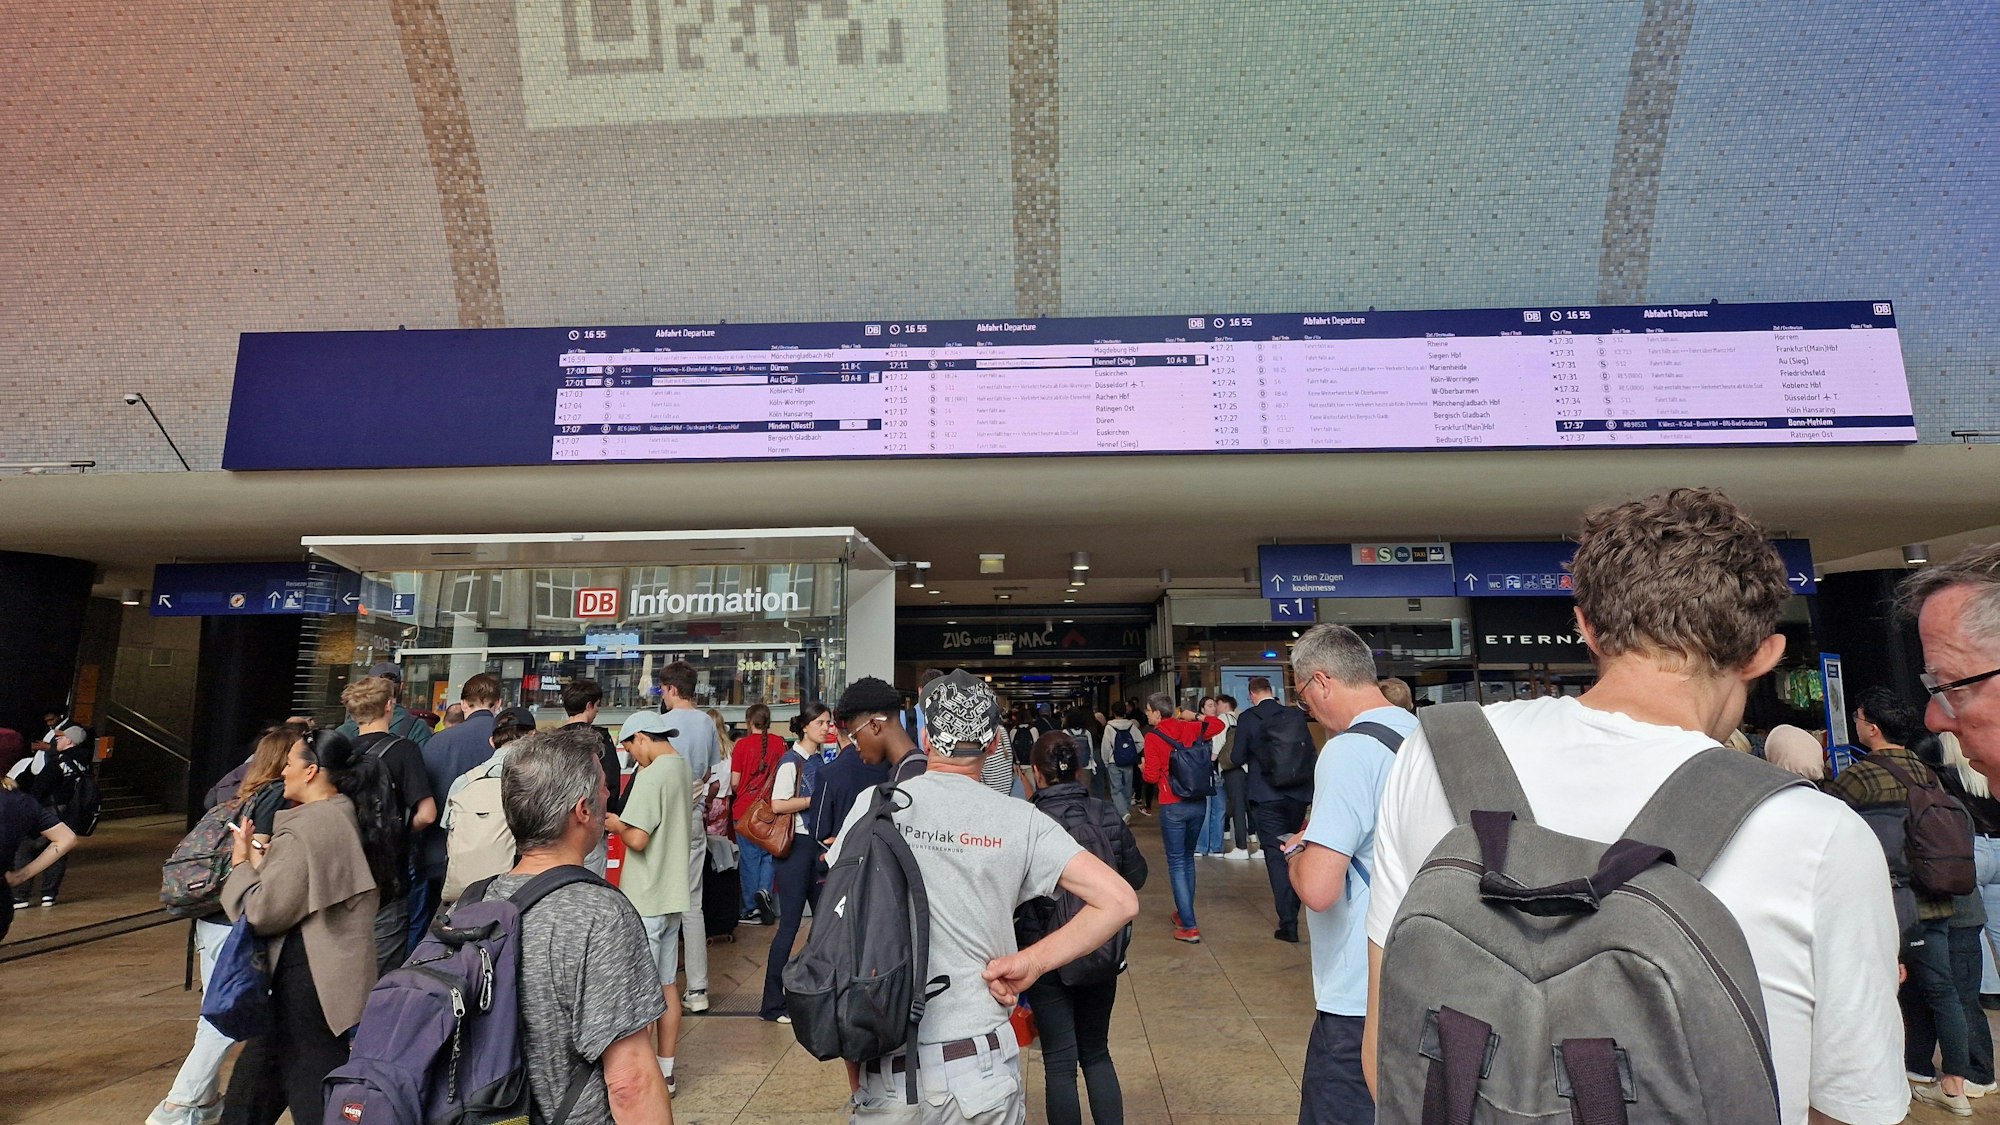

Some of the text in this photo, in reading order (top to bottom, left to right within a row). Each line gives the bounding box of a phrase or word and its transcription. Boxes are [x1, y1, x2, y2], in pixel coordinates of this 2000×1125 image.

[1875, 305, 1890, 314] DB
[1525, 312, 1540, 321] DB
[1567, 311, 1591, 319] 16 55
[1644, 310, 1709, 319] Abfahrt Departure
[1190, 319, 1204, 328] DB
[1230, 318, 1252, 327] 16 55
[1304, 317, 1366, 326] Abfahrt Departure
[866, 326, 880, 335] DB
[905, 325, 928, 333] 16 55
[977, 324, 1037, 332] Abfahrt Departure
[585, 331, 594, 339] 16
[656, 330, 716, 339] Abfahrt Departure
[1118, 357, 1136, 366] (Sieg)
[1789, 357, 1809, 366] (Sieg)
[780, 376, 798, 384] (Sieg)
[1096, 405, 1122, 413] Ratingen
[1803, 407, 1836, 415] Hansaring
[783, 411, 813, 419] Hansaring
[1434, 411, 1491, 421] Bergisch Gladbach
[791, 422, 814, 431] (Westf)
[768, 435, 794, 443] Bergisch
[1464, 435, 1482, 443] (Erft)
[1790, 431, 1820, 440] Ratingen
[1120, 440, 1139, 449] (Sieg)
[1379, 548, 1391, 562] S
[1320, 573, 1343, 583] Zügen
[1292, 584, 1336, 592] koelnmesse
[580, 587, 799, 615] DB Information
[1295, 599, 1303, 614] 1
[943, 631, 971, 649] ZUG
[1019, 629, 1057, 648] MAC.
[738, 658, 777, 671] Snack
[905, 826, 954, 843] Parylak
[960, 832, 1002, 849] GmbH
